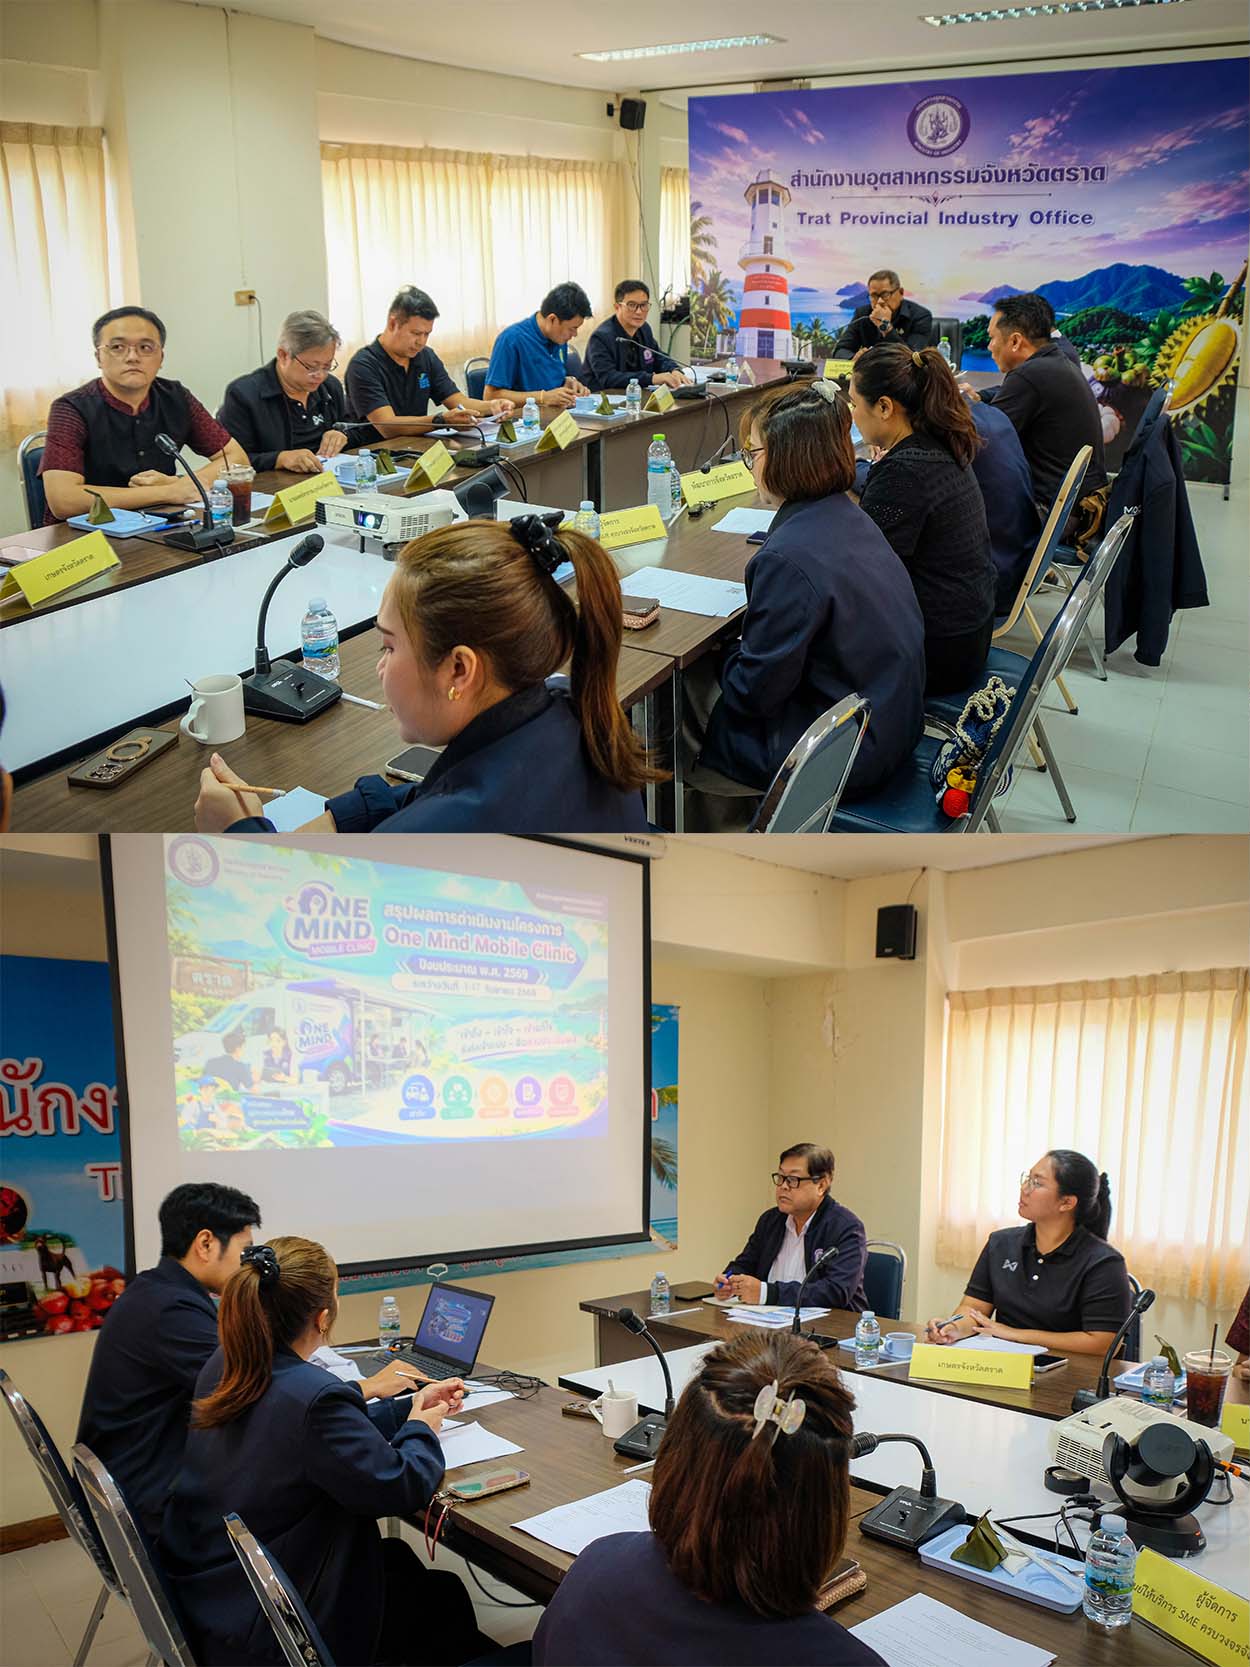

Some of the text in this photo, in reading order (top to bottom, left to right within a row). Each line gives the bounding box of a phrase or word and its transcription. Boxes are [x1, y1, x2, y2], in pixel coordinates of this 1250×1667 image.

[790, 163, 1106, 191] สำนักงานอุตสาหกรรมจังหวัดตราด
[797, 210, 1094, 228] Trat Provincial Industry Office
[299, 886, 369, 917] ONE
[293, 917, 372, 940] MIND
[385, 926, 577, 962] One Mind Mobile Clinic
[0, 1058, 119, 1134] นักง
[1178, 1609, 1200, 1628] SME
[1196, 1591, 1239, 1623] ผู้จัดการ
